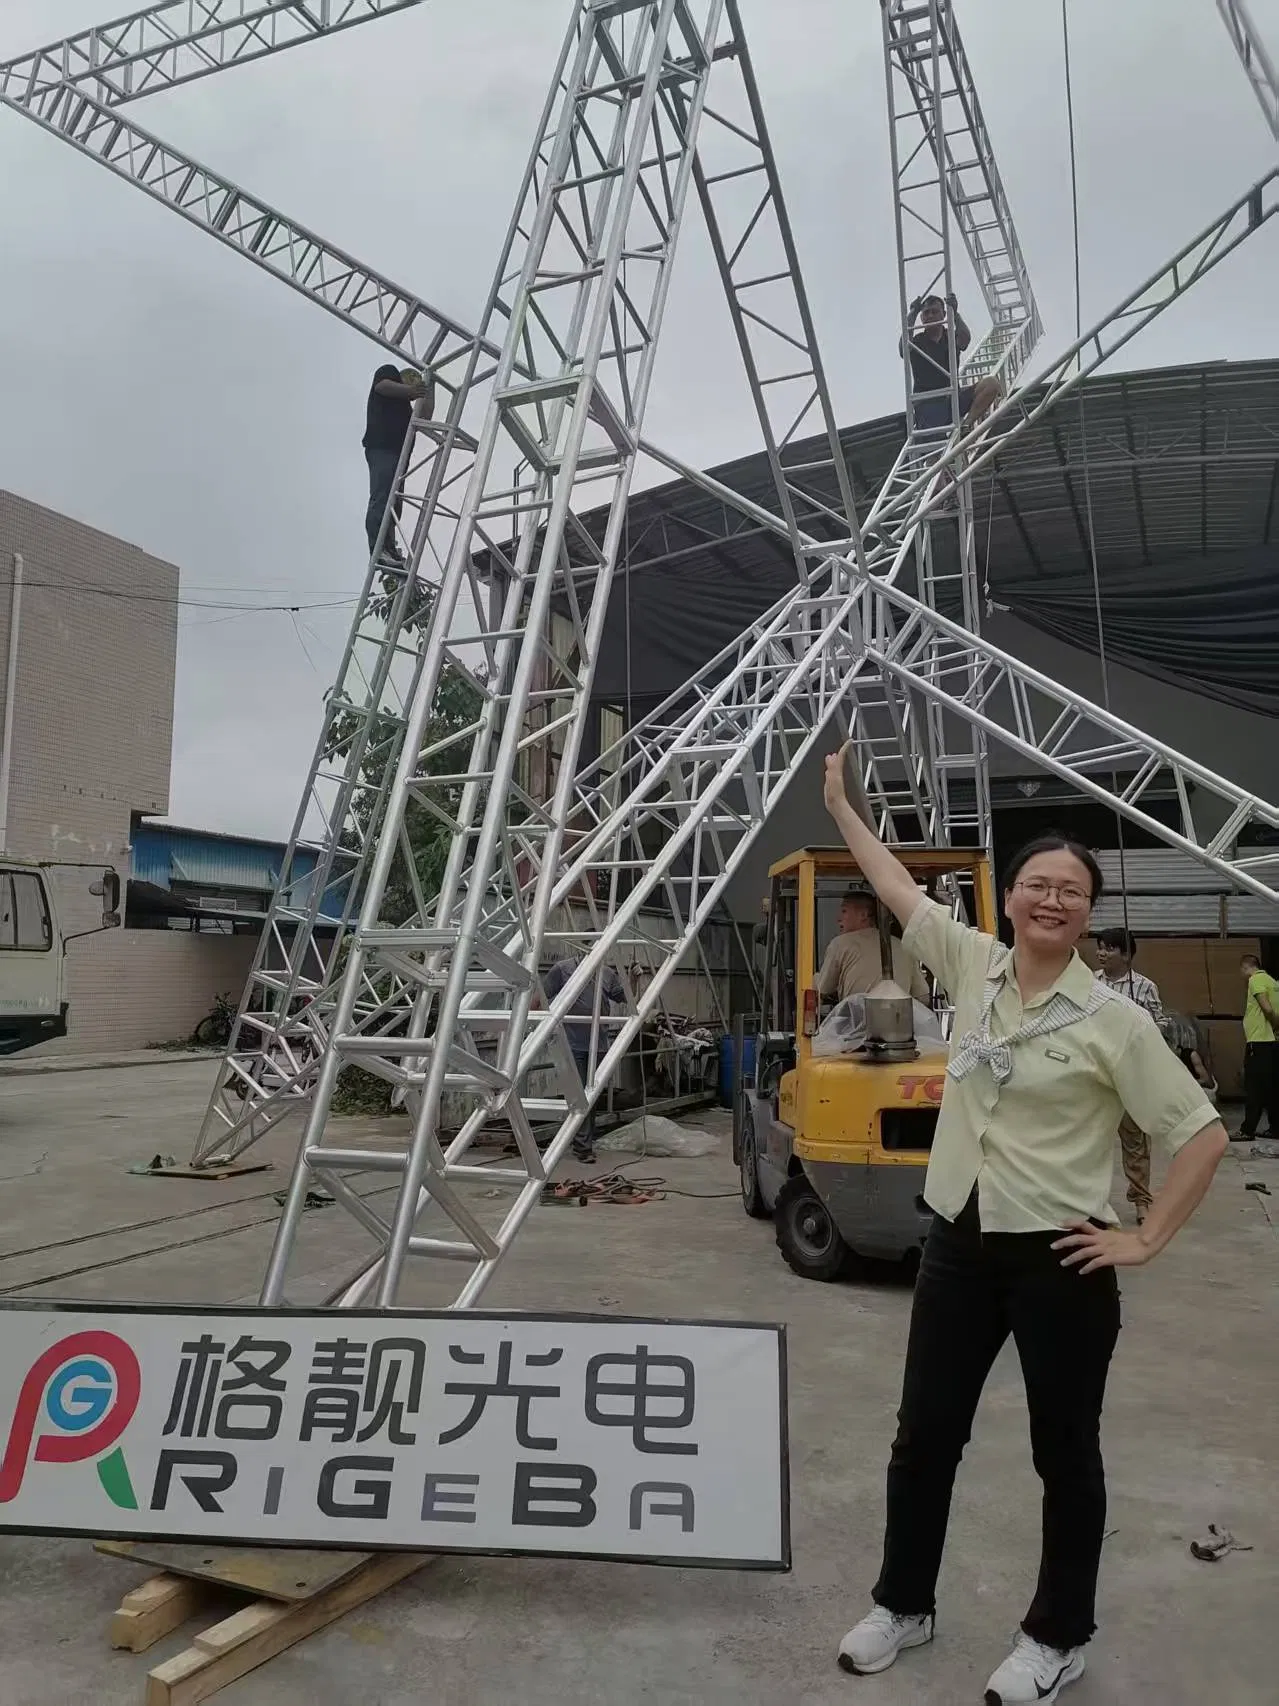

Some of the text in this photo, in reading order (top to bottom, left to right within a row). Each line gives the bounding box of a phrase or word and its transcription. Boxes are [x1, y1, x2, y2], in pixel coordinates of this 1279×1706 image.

[896, 1075, 946, 1100] TC
[162, 1334, 698, 1456] 格靓光电
[150, 1449, 695, 1533] RIGEBA
